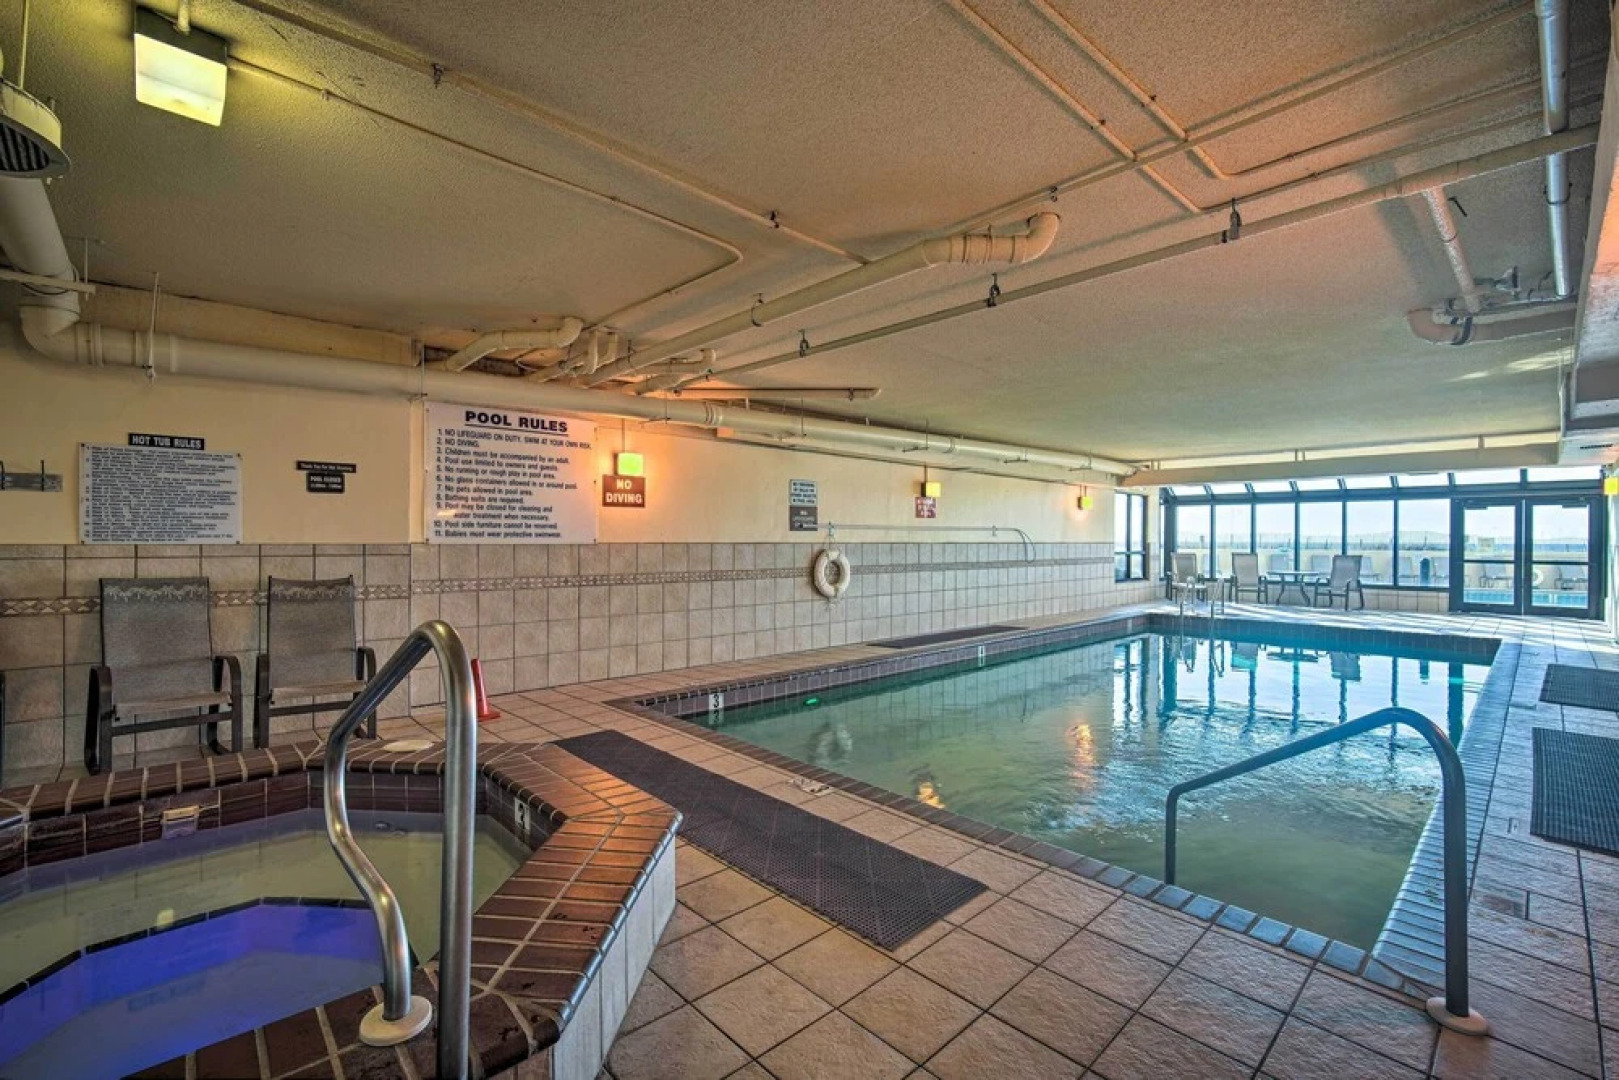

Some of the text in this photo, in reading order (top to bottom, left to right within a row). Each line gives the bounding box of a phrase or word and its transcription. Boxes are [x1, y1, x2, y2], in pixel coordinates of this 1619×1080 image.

[465, 410, 568, 432] POOL RULES
[132, 435, 202, 449] HOT TUB RULES
[445, 429, 455, 437] NO
[457, 430, 492, 440] LIFEGUARD
[565, 440, 577, 448] OWN
[445, 438, 455, 446] NO
[445, 447, 471, 456] Children
[500, 452, 537, 462] accompanied
[616, 478, 632, 490] NO
[605, 492, 643, 504] DIVING
[714, 693, 720, 708] 3
